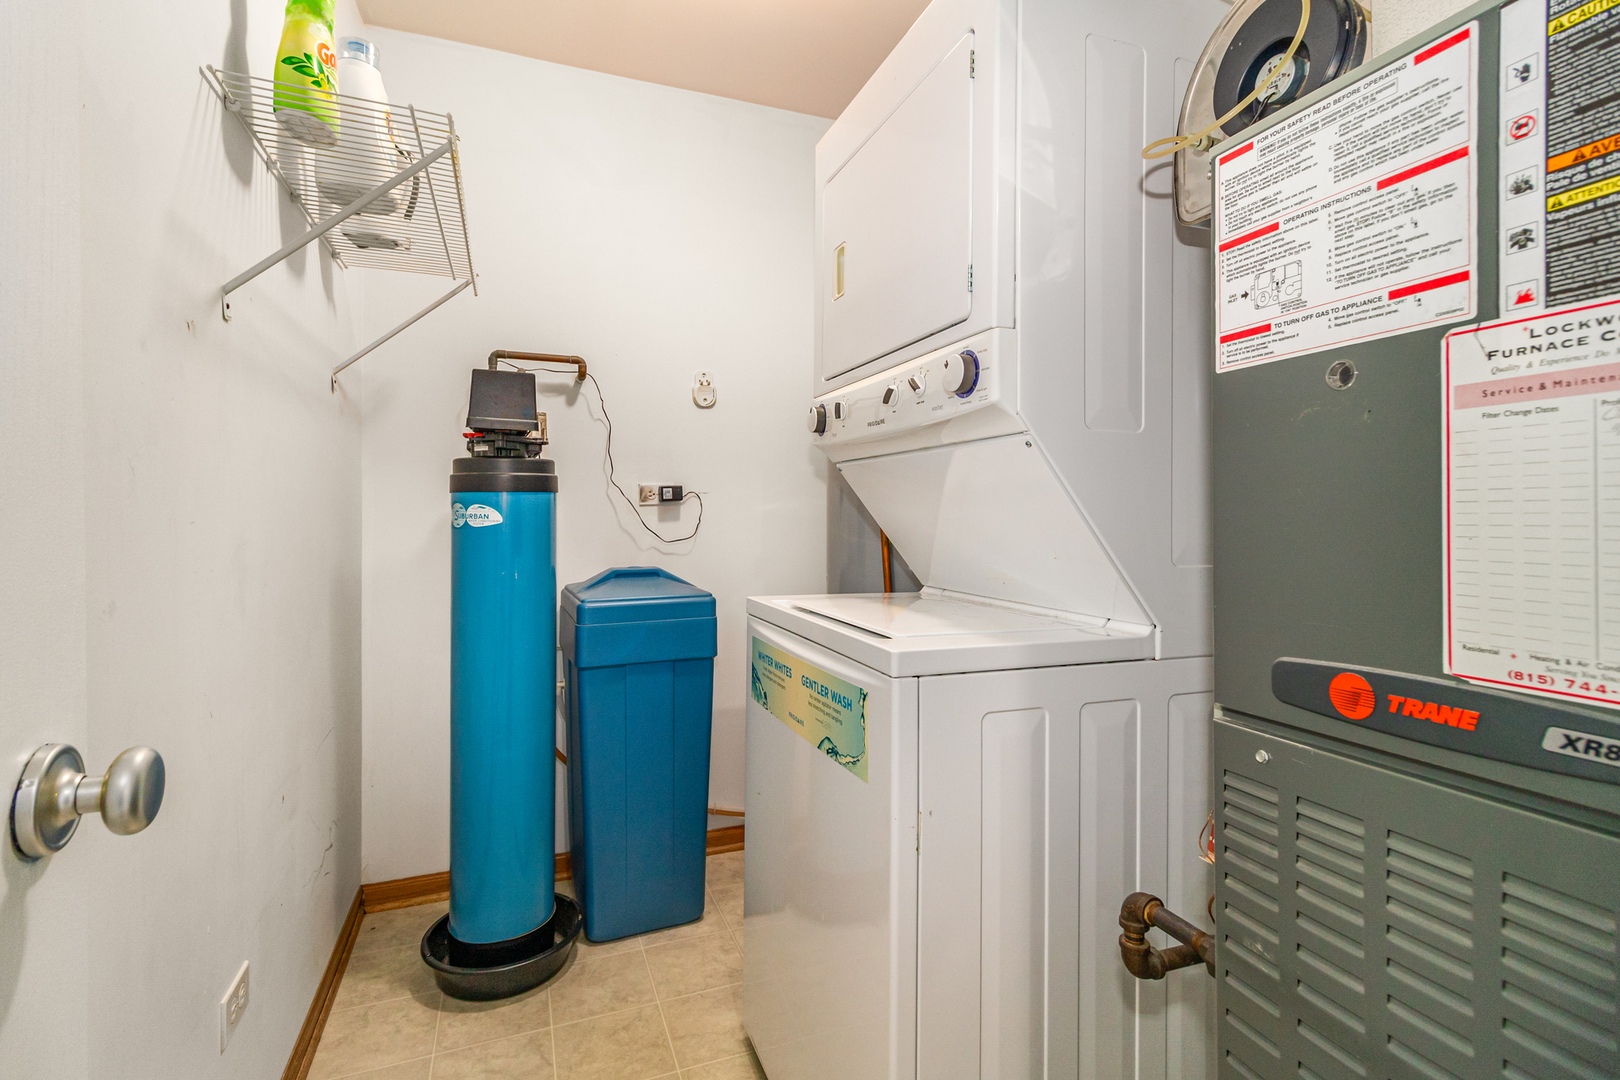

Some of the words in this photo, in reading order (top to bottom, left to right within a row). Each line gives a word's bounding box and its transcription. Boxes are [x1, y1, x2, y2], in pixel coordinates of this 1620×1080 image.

[1256, 133, 1268, 145] FOR
[1269, 124, 1285, 138] YOUR
[1286, 111, 1311, 129] SAFETY
[1312, 101, 1331, 116] READ
[1332, 85, 1361, 106] BEFORE
[1362, 61, 1406, 90] OPERATING
[1572, 172, 1588, 182] de
[1588, 158, 1604, 169] de
[1282, 205, 1319, 225] OPERATING
[1320, 184, 1371, 210] INSTRUCTIONS
[1283, 316, 1299, 326] TURN
[1300, 312, 1313, 322] OFF
[1314, 309, 1329, 318] GAS
[1330, 306, 1339, 314] TO
[1341, 294, 1382, 311] APPLIANCE
[1487, 336, 1590, 361] FURNACE
[1601, 330, 1620, 342] C
[1482, 386, 1533, 398] Service
[1538, 382, 1546, 390] &
[1482, 410, 1501, 419] Filter
[1504, 408, 1532, 417] Change
[1535, 406, 1559, 414] Dates
[1462, 644, 1499, 655] Residential
[1530, 654, 1560, 665] Heating
[758, 650, 773, 668] WHITER
[774, 660, 792, 678] WHITES
[1508, 670, 1555, 686] (815)
[801, 675, 829, 699] GENTLER
[830, 689, 852, 712] WASH
[1388, 694, 1480, 732] TRANE
[1558, 733, 1620, 761] XR8
